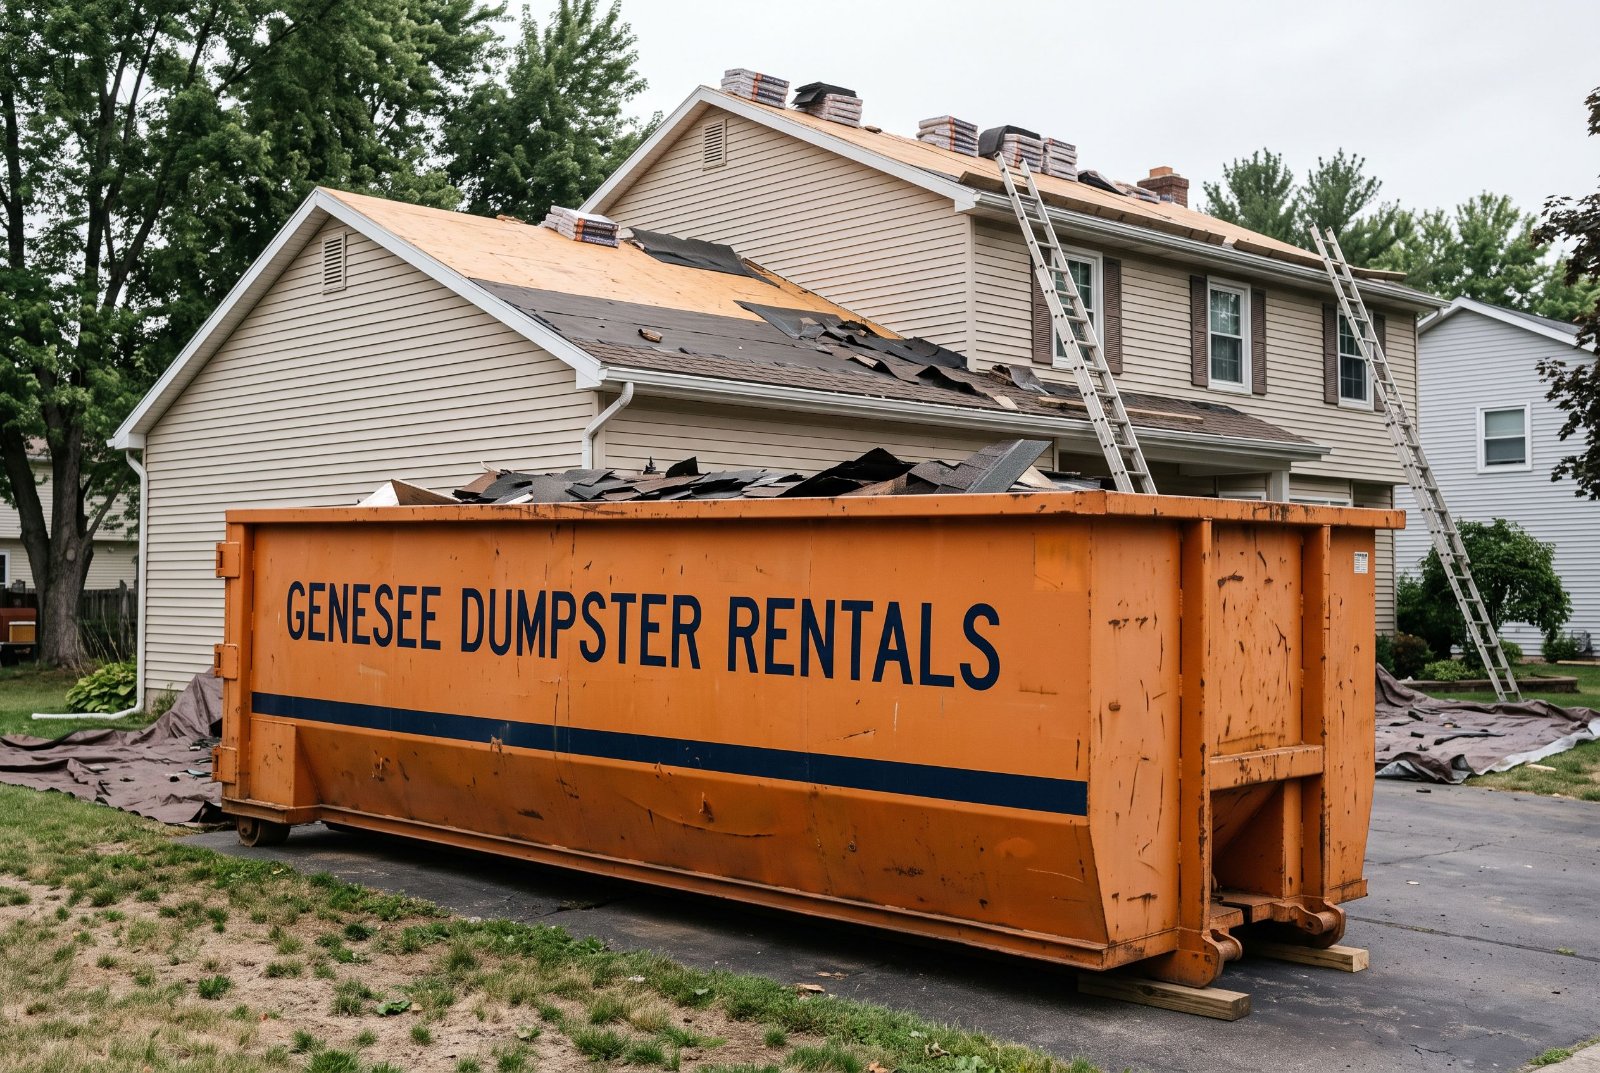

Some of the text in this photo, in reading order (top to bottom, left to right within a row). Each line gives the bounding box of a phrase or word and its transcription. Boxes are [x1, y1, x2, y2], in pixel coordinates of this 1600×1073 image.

[286, 580, 1001, 691] GENESEE DUMPSTER RENTALS
